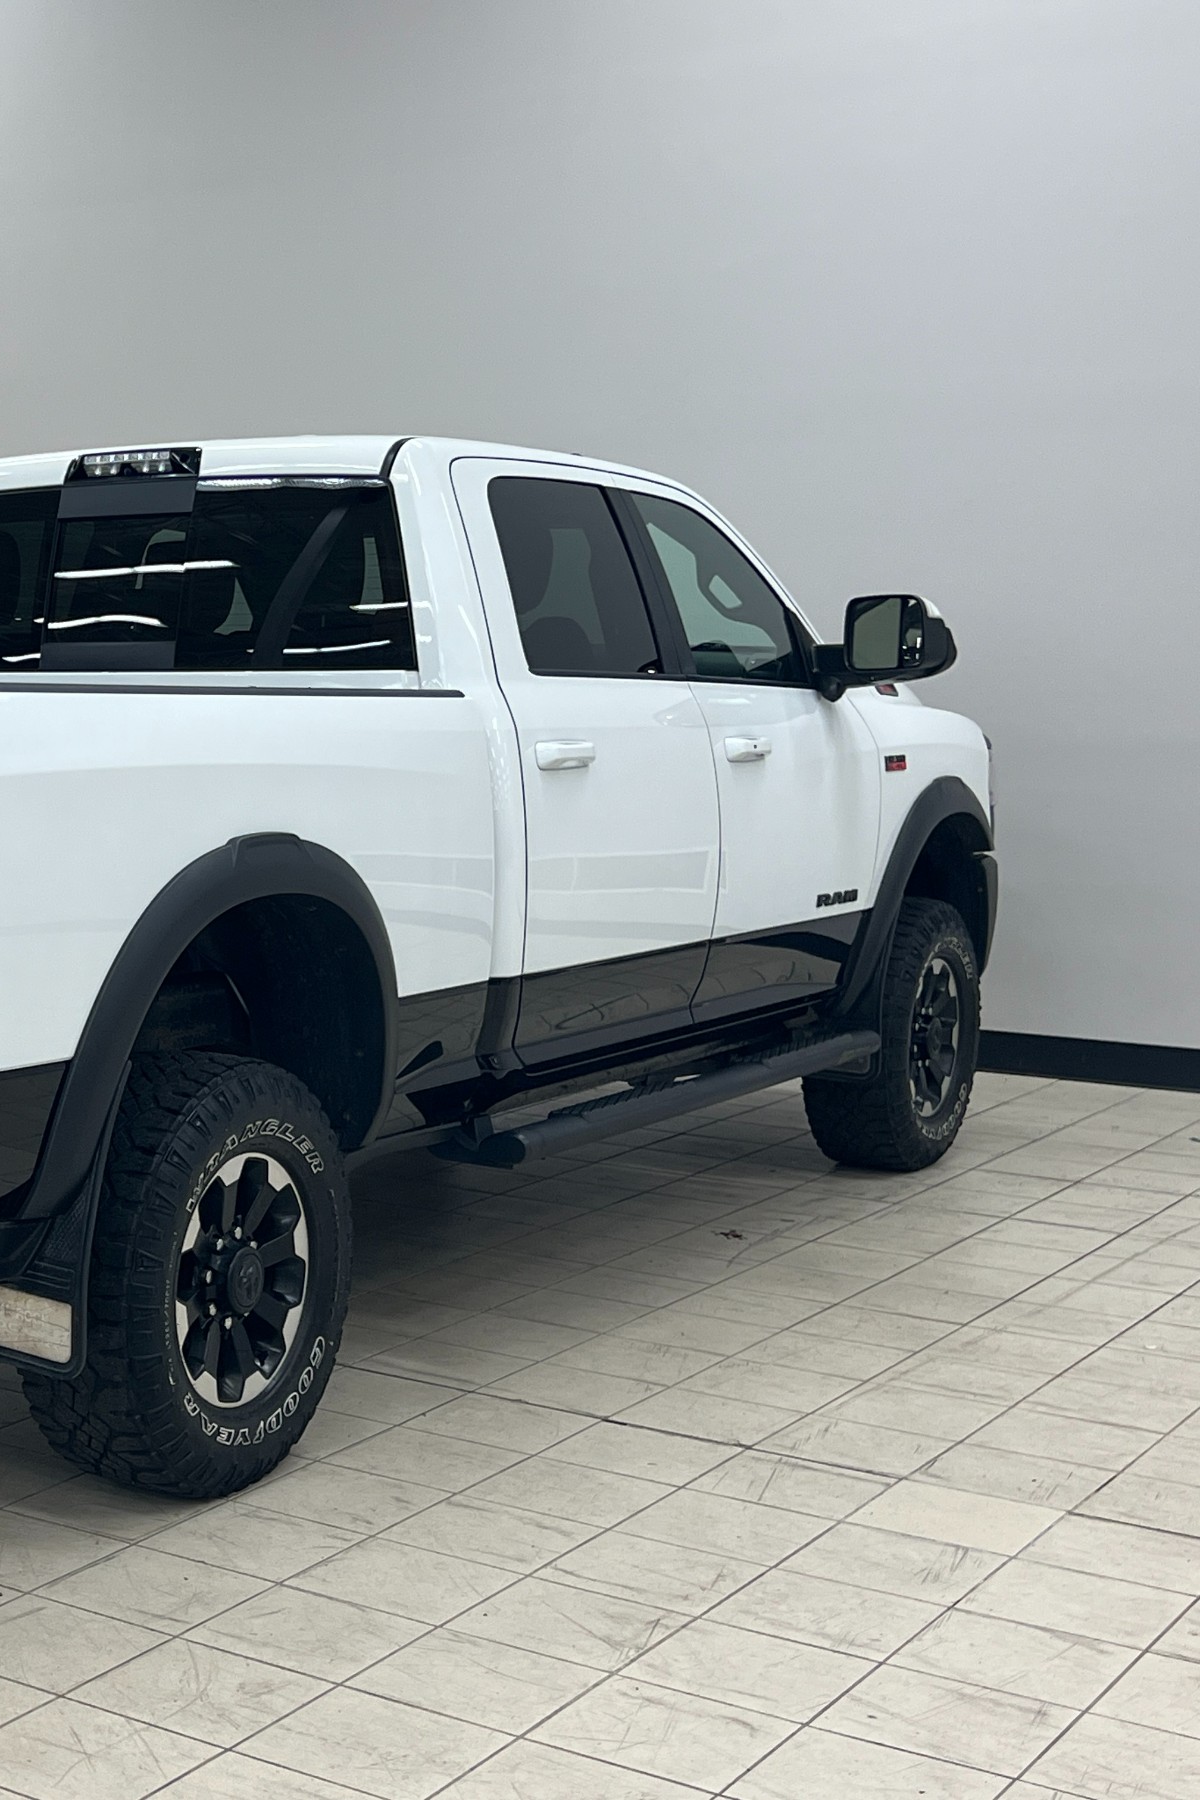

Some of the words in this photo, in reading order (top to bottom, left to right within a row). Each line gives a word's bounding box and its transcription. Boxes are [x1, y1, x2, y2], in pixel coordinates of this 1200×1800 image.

[816, 889, 858, 908] RAM
[185, 1118, 325, 1214] WRANGLER
[183, 1335, 326, 1446] GOODYEAR
